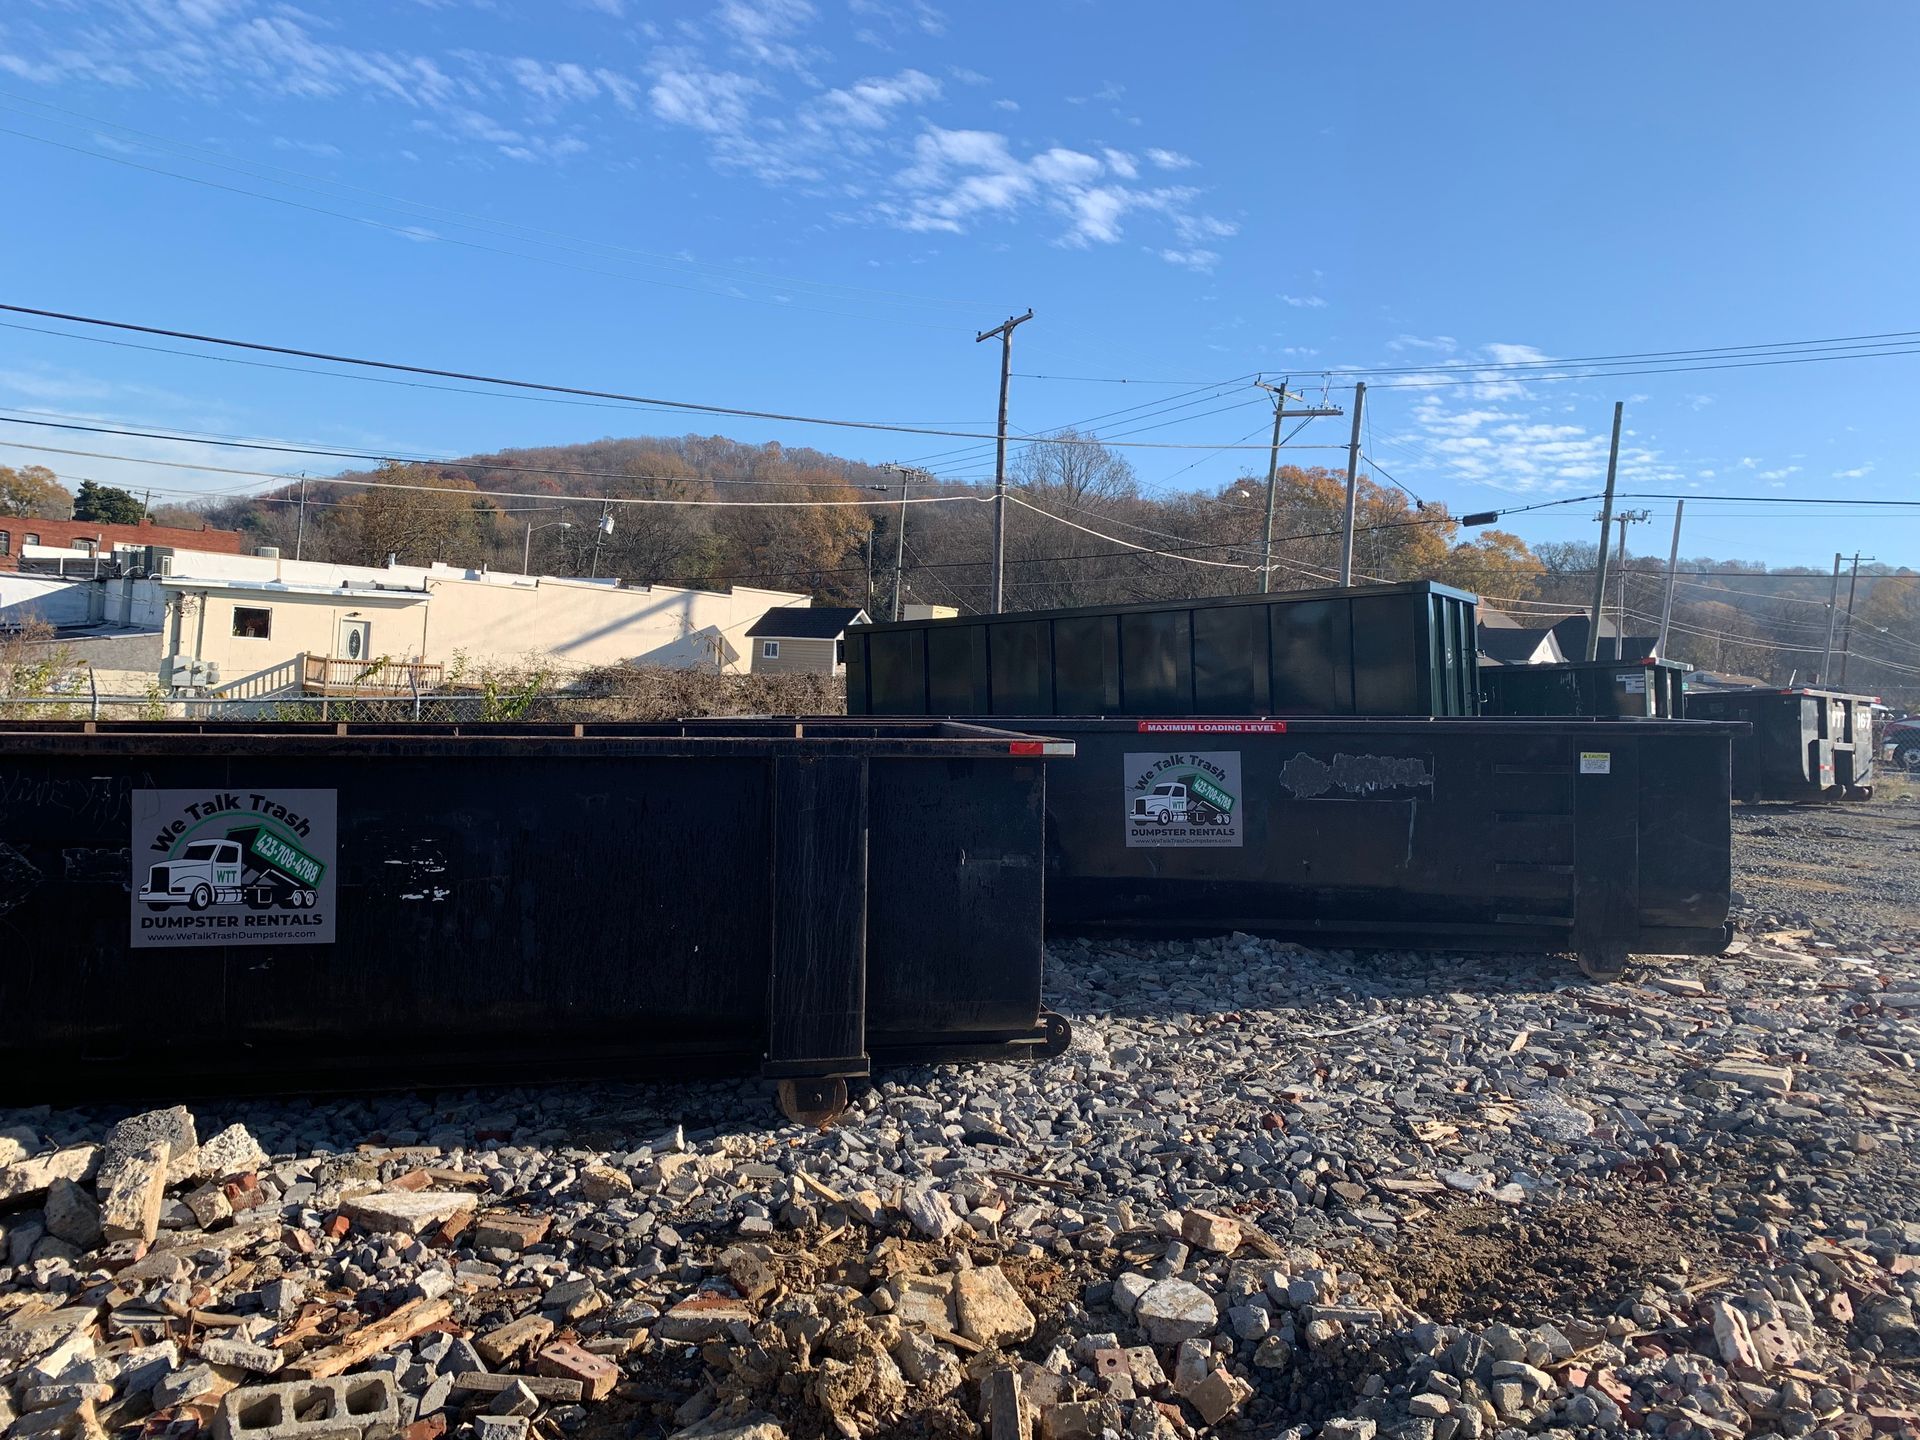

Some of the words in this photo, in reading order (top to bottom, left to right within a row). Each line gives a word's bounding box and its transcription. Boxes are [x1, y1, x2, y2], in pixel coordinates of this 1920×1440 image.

[1134, 770, 1155, 791] We
[1153, 754, 1185, 772] Talk
[1189, 754, 1227, 782] Trash
[1172, 801, 1185, 810] WTT
[150, 819, 187, 853] We
[184, 792, 241, 822] Talk
[249, 793, 312, 839] Trash
[1131, 828, 1187, 837] DUMPSTER
[1189, 828, 1235, 836] RENTALS
[216, 870, 237, 884] WTT
[141, 915, 239, 929] DUMPSTER
[244, 914, 323, 927] RENTALS
[147, 930, 316, 942] www.WeTalkTrashDumpsters.com
